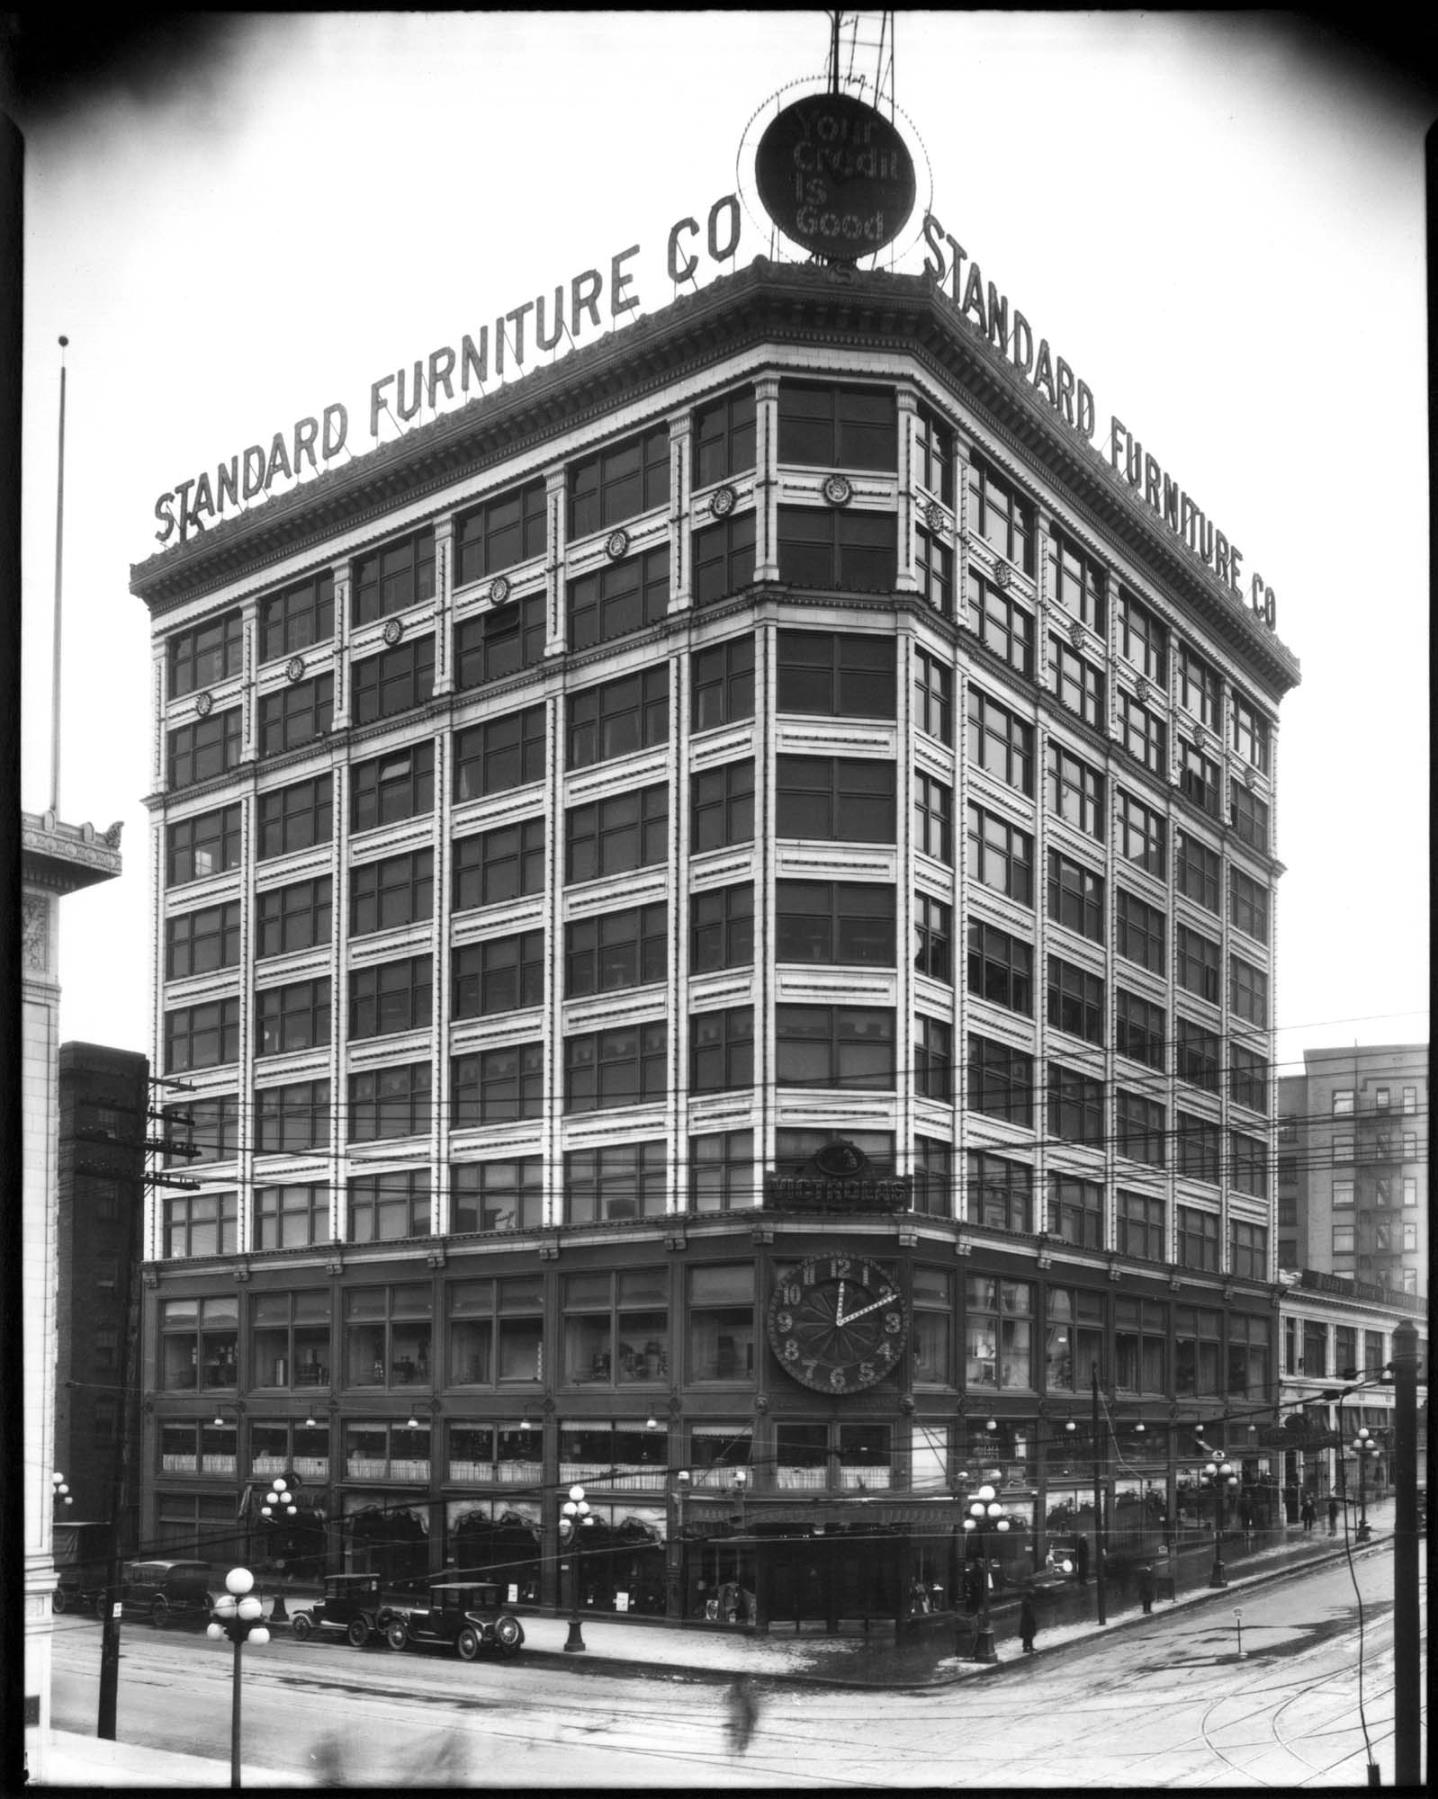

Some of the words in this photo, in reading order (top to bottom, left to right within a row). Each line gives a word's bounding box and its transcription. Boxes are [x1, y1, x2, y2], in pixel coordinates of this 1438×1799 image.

[793, 141, 898, 180] Credit
[796, 205, 884, 241] Good
[154, 403, 349, 543] STANDARD
[370, 244, 640, 436] FURNITURE
[667, 193, 741, 284] CO
[923, 214, 1096, 439] STANDARD
[1110, 415, 1244, 601] FURNITURE
[1252, 572, 1277, 632] CO
[803, 1263, 816, 1285] 11
[830, 1259, 851, 1279] 12
[862, 1265, 870, 1287] 1
[783, 1284, 802, 1305] 10
[776, 1311, 793, 1333] 9
[884, 1312, 901, 1334] 3
[784, 1339, 800, 1361] 8
[876, 1341, 893, 1361] 4
[801, 1359, 818, 1379] 7
[829, 1367, 846, 1388] 6
[858, 1362, 875, 1382] 5
